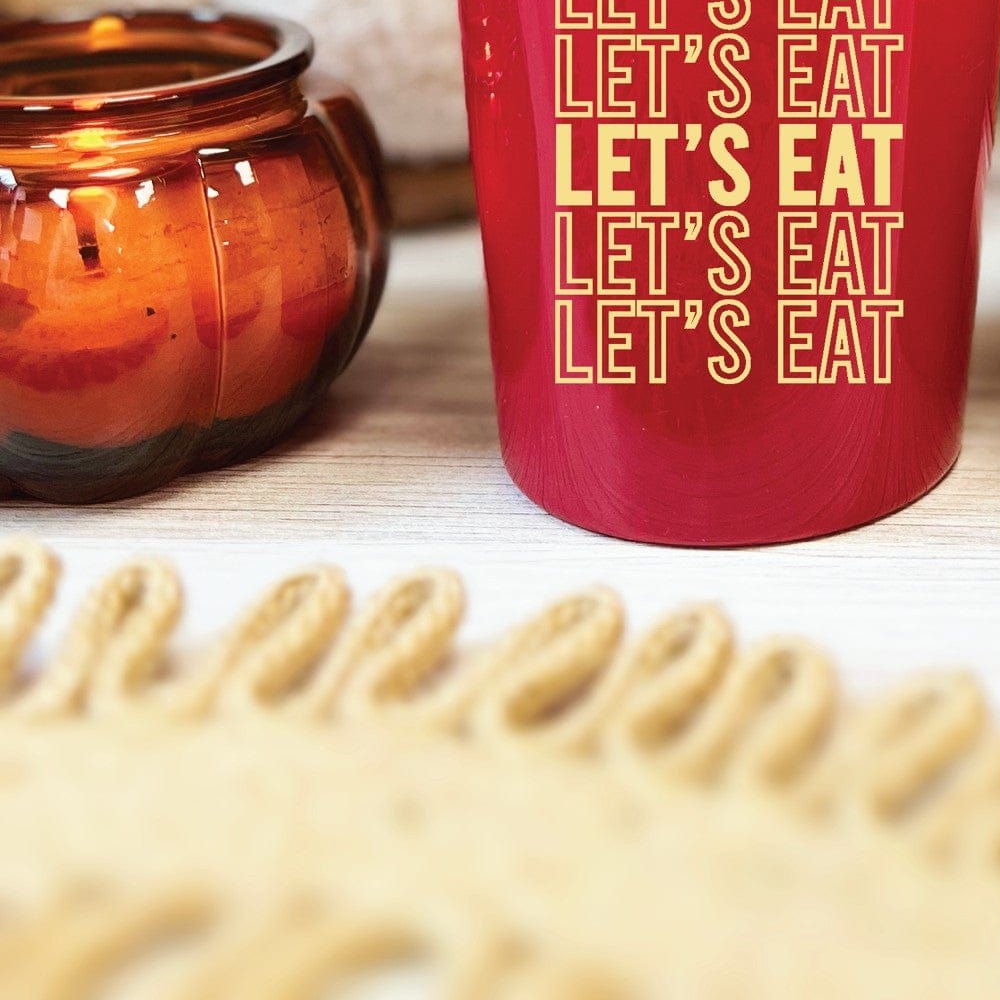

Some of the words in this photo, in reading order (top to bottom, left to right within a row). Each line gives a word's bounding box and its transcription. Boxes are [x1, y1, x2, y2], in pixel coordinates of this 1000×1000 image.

[554, 32, 752, 118] LET'S
[777, 34, 904, 118] EAT
[554, 122, 752, 206] LET'S
[777, 123, 904, 206] EAT
[554, 210, 752, 296] LET'S
[777, 211, 904, 296] EAT
[554, 298, 752, 384] LET'S
[777, 299, 904, 384] EAT
